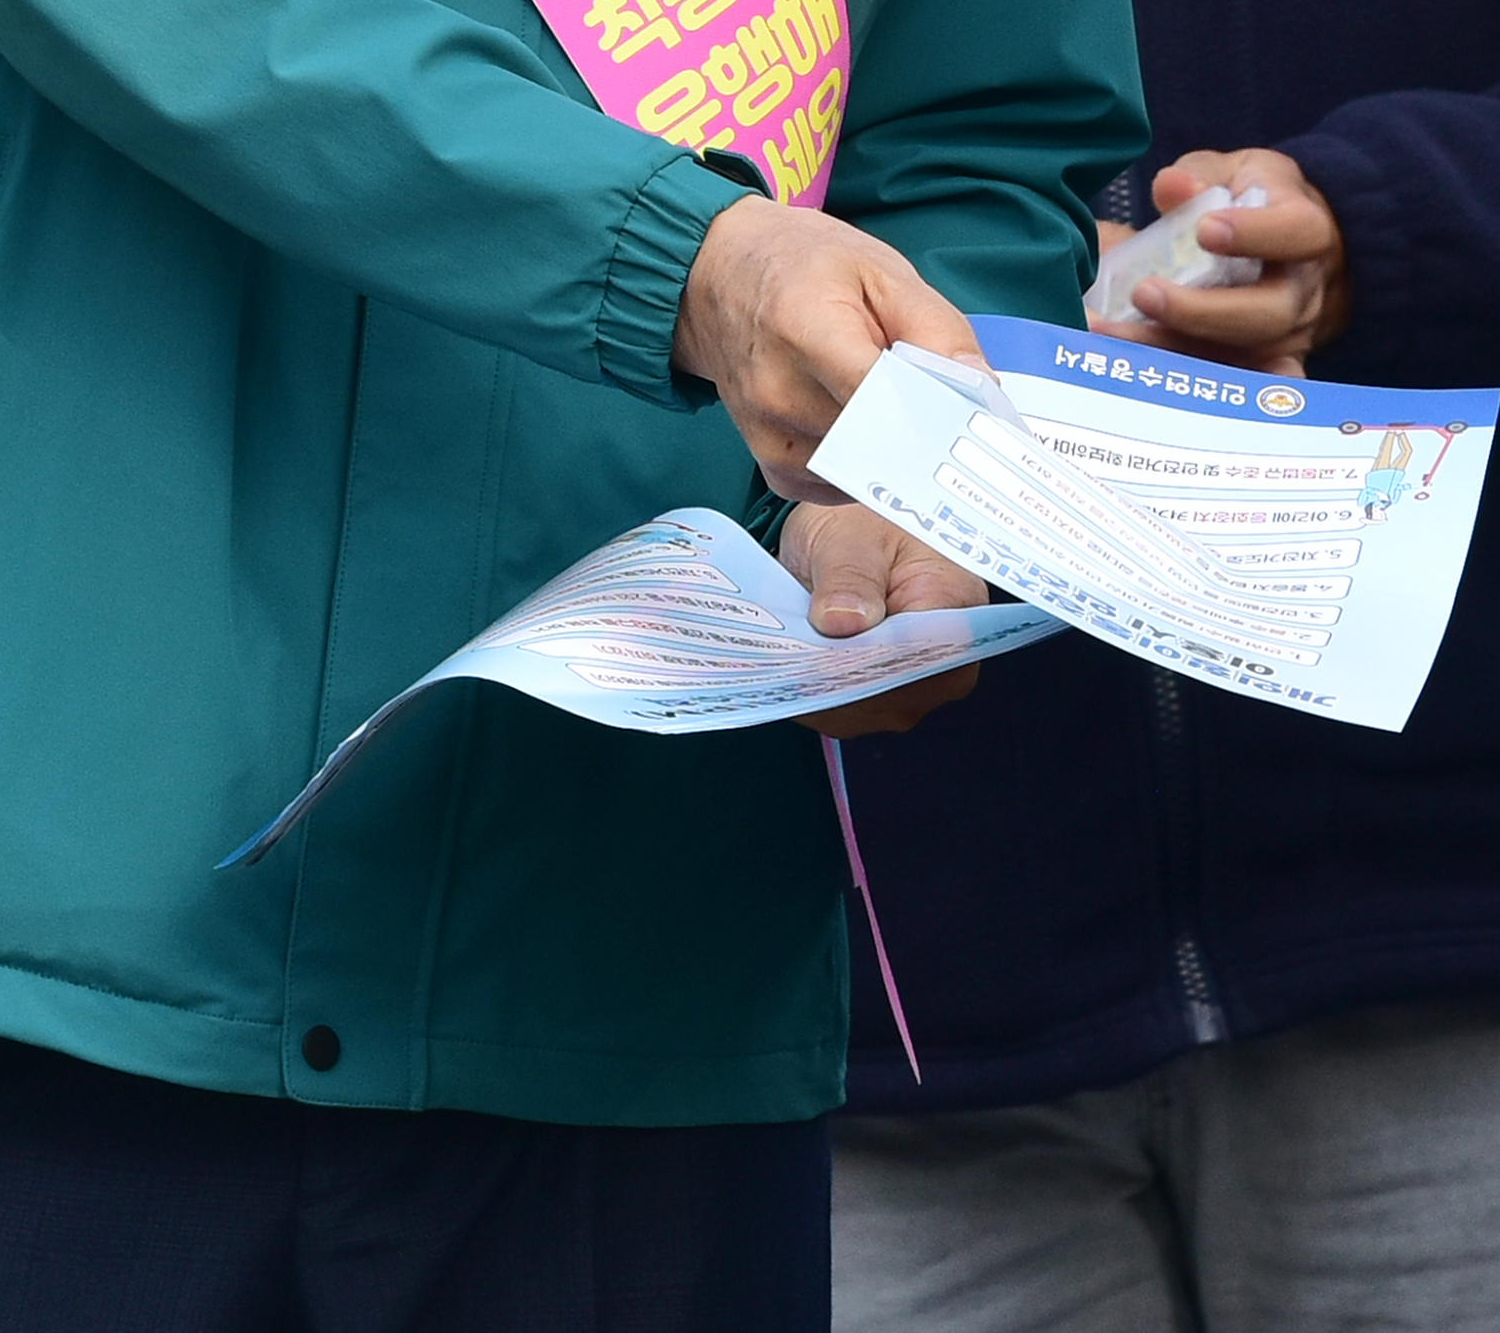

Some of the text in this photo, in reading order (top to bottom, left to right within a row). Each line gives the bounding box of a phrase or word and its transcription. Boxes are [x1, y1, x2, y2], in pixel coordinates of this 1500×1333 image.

[763, 68, 843, 206] 세요
[1052, 343, 1247, 407] 인천연수경찰서
[1053, 437, 1124, 467] 확보하며
[1127, 455, 1199, 475] 안전거리
[1202, 463, 1220, 477] 및
[1224, 466, 1261, 478] 준수
[1340, 468, 1358, 479] 7.
[1334, 510, 1352, 521] 6.
[1324, 549, 1342, 560] 5.
